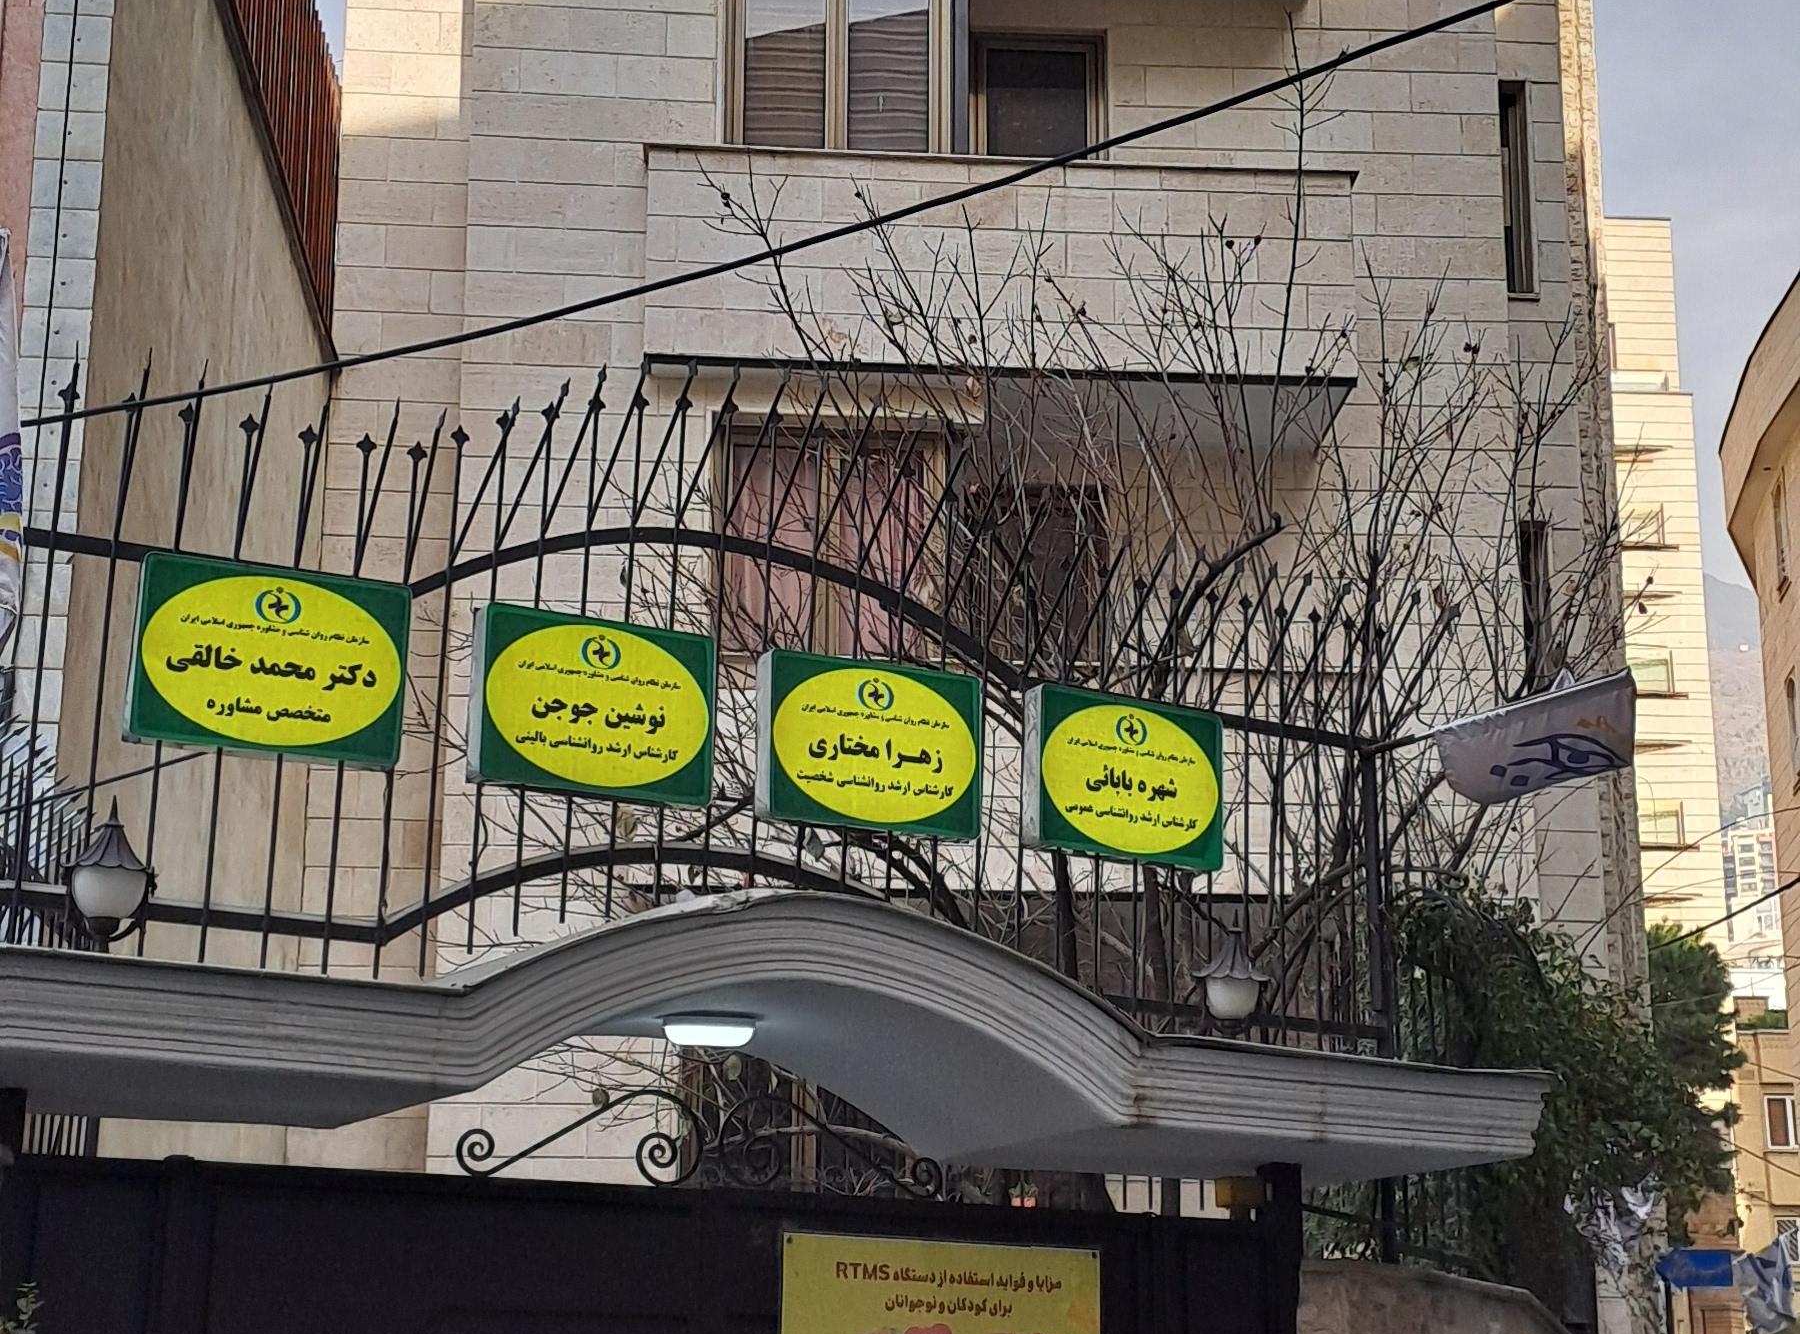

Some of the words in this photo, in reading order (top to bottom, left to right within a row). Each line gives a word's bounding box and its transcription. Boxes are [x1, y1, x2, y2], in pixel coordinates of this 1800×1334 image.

[180, 614, 199, 624] ایران
[201, 617, 226, 625] اسلامی
[166, 644, 242, 672] خالقی
[250, 657, 316, 681] محمد
[322, 663, 377, 691] دکتر
[206, 697, 262, 716] مشاوره
[266, 703, 331, 723] متخصص
[531, 695, 598, 725] جوجن
[605, 703, 666, 734] نوشین
[515, 730, 547, 746] بالینی
[549, 735, 604, 754] روانشناسی
[808, 733, 880, 761] مختاری
[606, 742, 631, 757] ارشد
[633, 746, 679, 763] کارشناس
[886, 738, 943, 773] زهرا
[796, 770, 834, 784] شخصیت
[837, 775, 885, 792] روانشناسی
[888, 780, 911, 795] ارشد
[913, 784, 954, 799] کارشناس
[1137, 778, 1178, 802] شهره
[1065, 803, 1093, 814] عمومی
[1096, 806, 1138, 824] روانشناسی
[1140, 811, 1160, 826] ارشد
[1161, 816, 1198, 831] کارشناس
[836, 1261, 890, 1281] RTMS
[893, 1266, 936, 1285] دستگاه
[937, 1269, 947, 1289] از
[950, 1270, 994, 1287] استفاده
[996, 1271, 1026, 1292] فواید
[1027, 1279, 1033, 1293] و
[1036, 1274, 1062, 1293] مزایا
[885, 1293, 937, 1314] نوجوانان
[938, 1302, 945, 1314] و
[947, 1296, 987, 1317] کودکان
[989, 1299, 1012, 1317] برای
